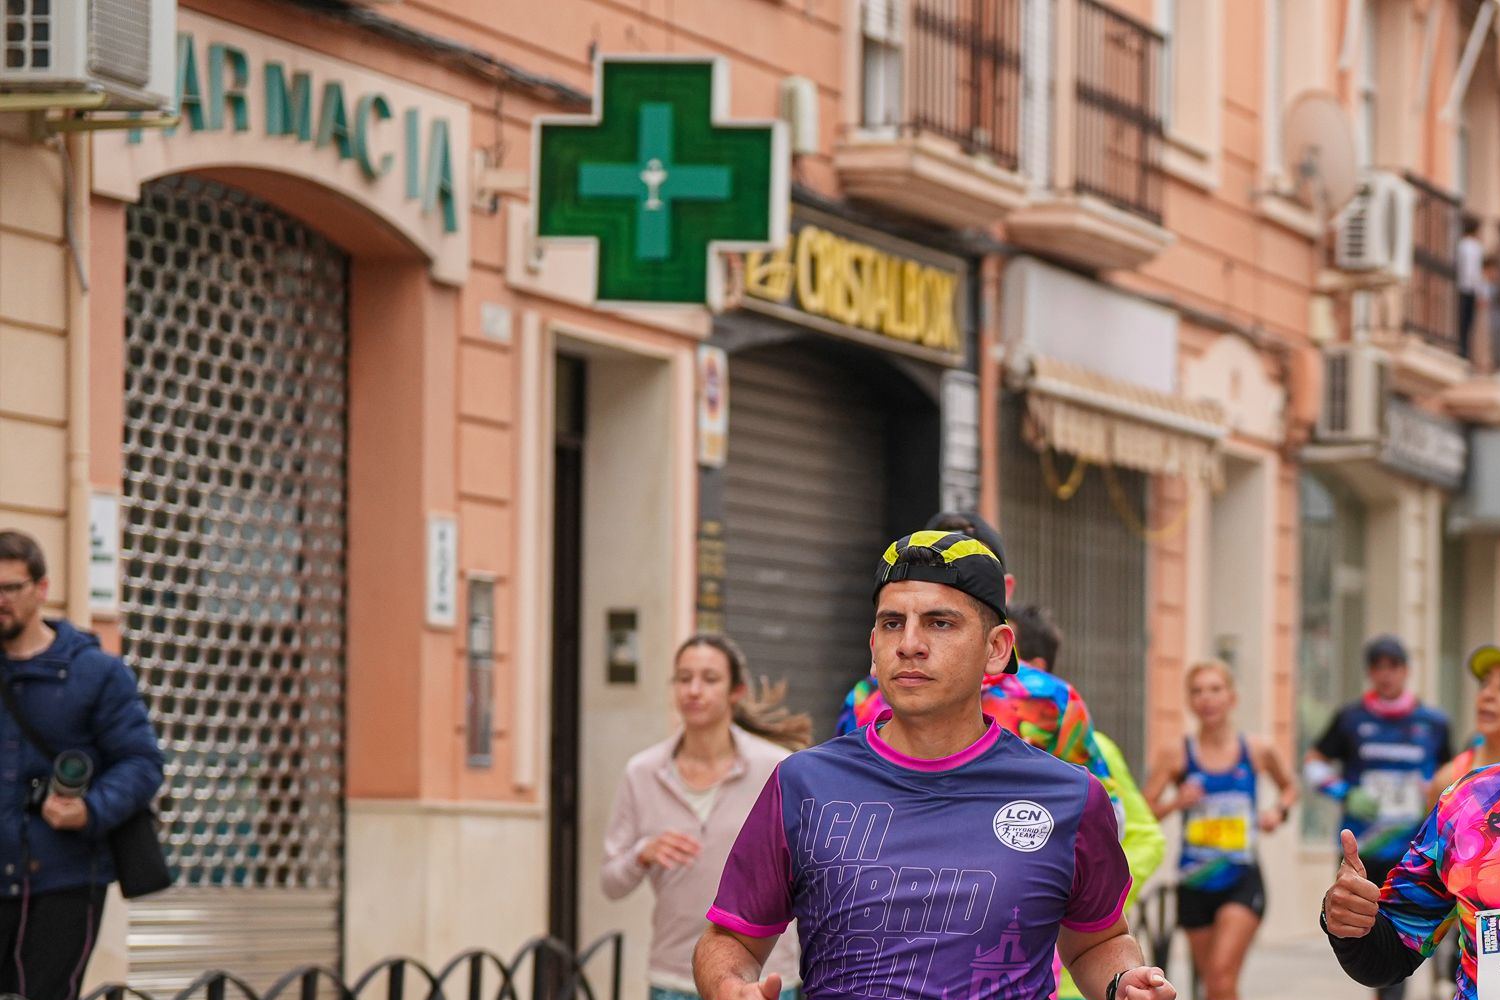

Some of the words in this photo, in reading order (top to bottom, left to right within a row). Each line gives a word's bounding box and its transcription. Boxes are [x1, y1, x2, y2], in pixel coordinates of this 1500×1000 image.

[128, 32, 458, 234] ARMACIA
[1006, 809, 1042, 821] LCN
[1015, 831, 1036, 839] TEAM
